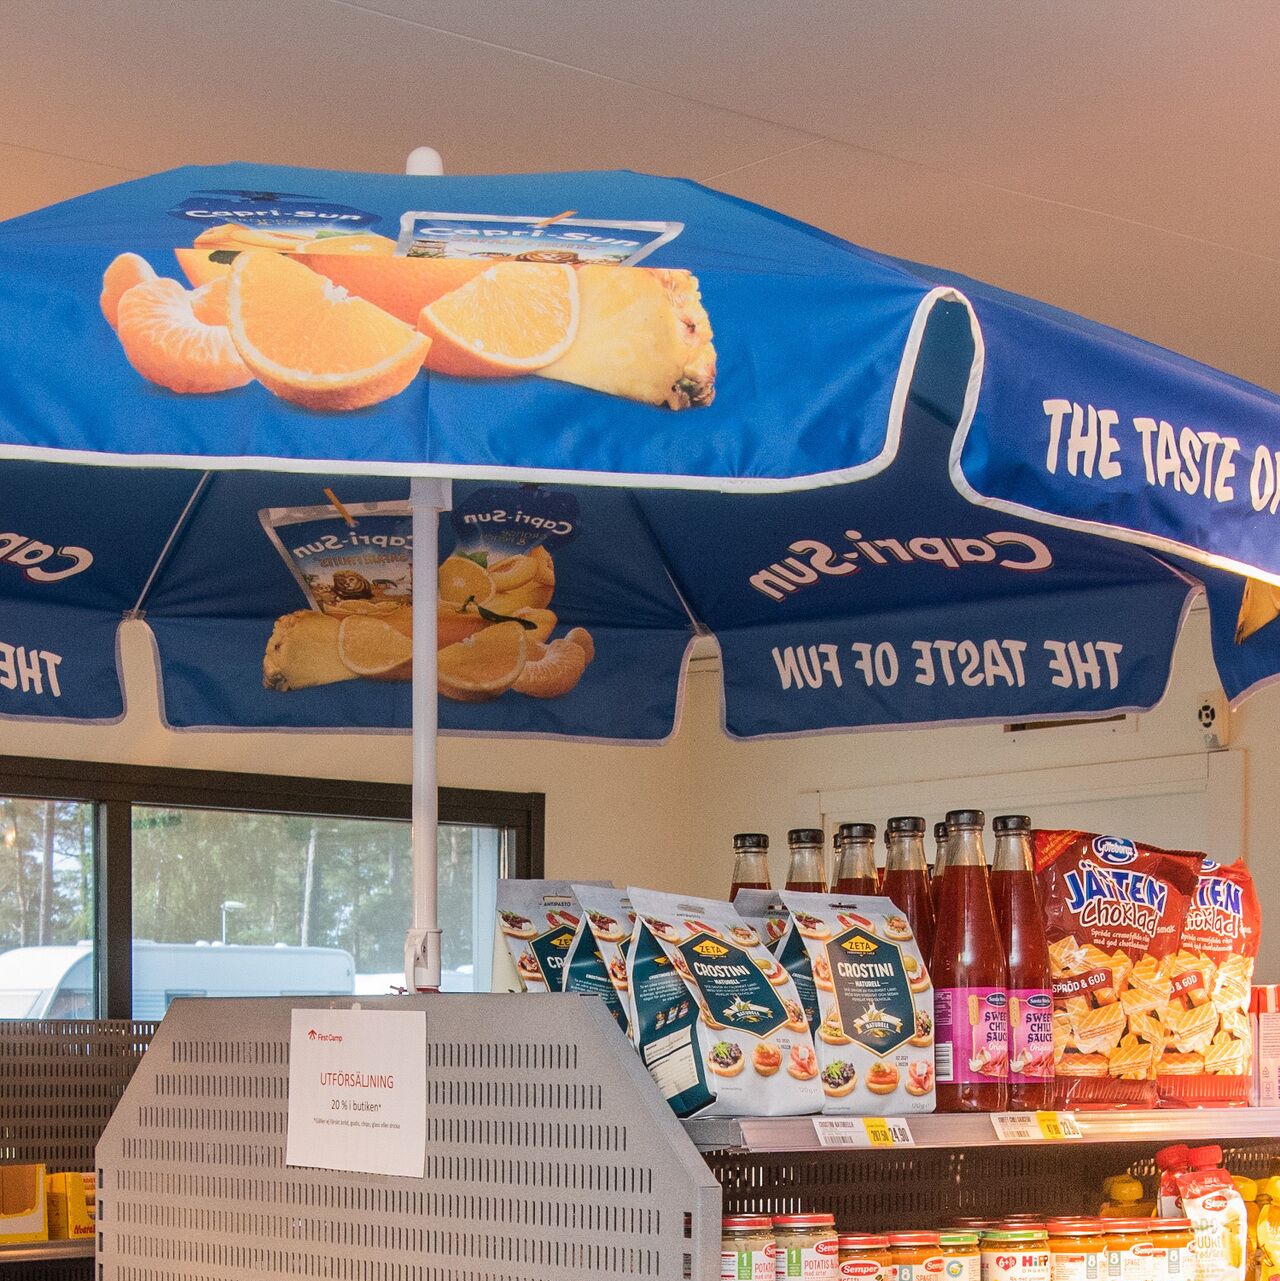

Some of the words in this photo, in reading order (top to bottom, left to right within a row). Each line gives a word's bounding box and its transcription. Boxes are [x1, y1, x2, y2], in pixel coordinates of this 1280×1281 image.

[185, 209, 363, 222] Capri-Sun
[420, 225, 641, 248] Capri-Sun
[1042, 400, 1121, 479] THE
[1132, 418, 1241, 502] TASTE
[1081, 898, 1159, 938] Choklad
[848, 941, 871, 950] ZETA
[693, 962, 750, 977] CROSTINI
[837, 963, 894, 978] CROSTINI
[1052, 977, 1079, 994] SPRÖD
[1091, 973, 1106, 987] GOD
[321, 1071, 393, 1089] UTFÖRSÄLJNING
[332, 1100, 340, 1110] 20
[342, 1101, 348, 1110] %
[843, 1264, 878, 1275] Semper
